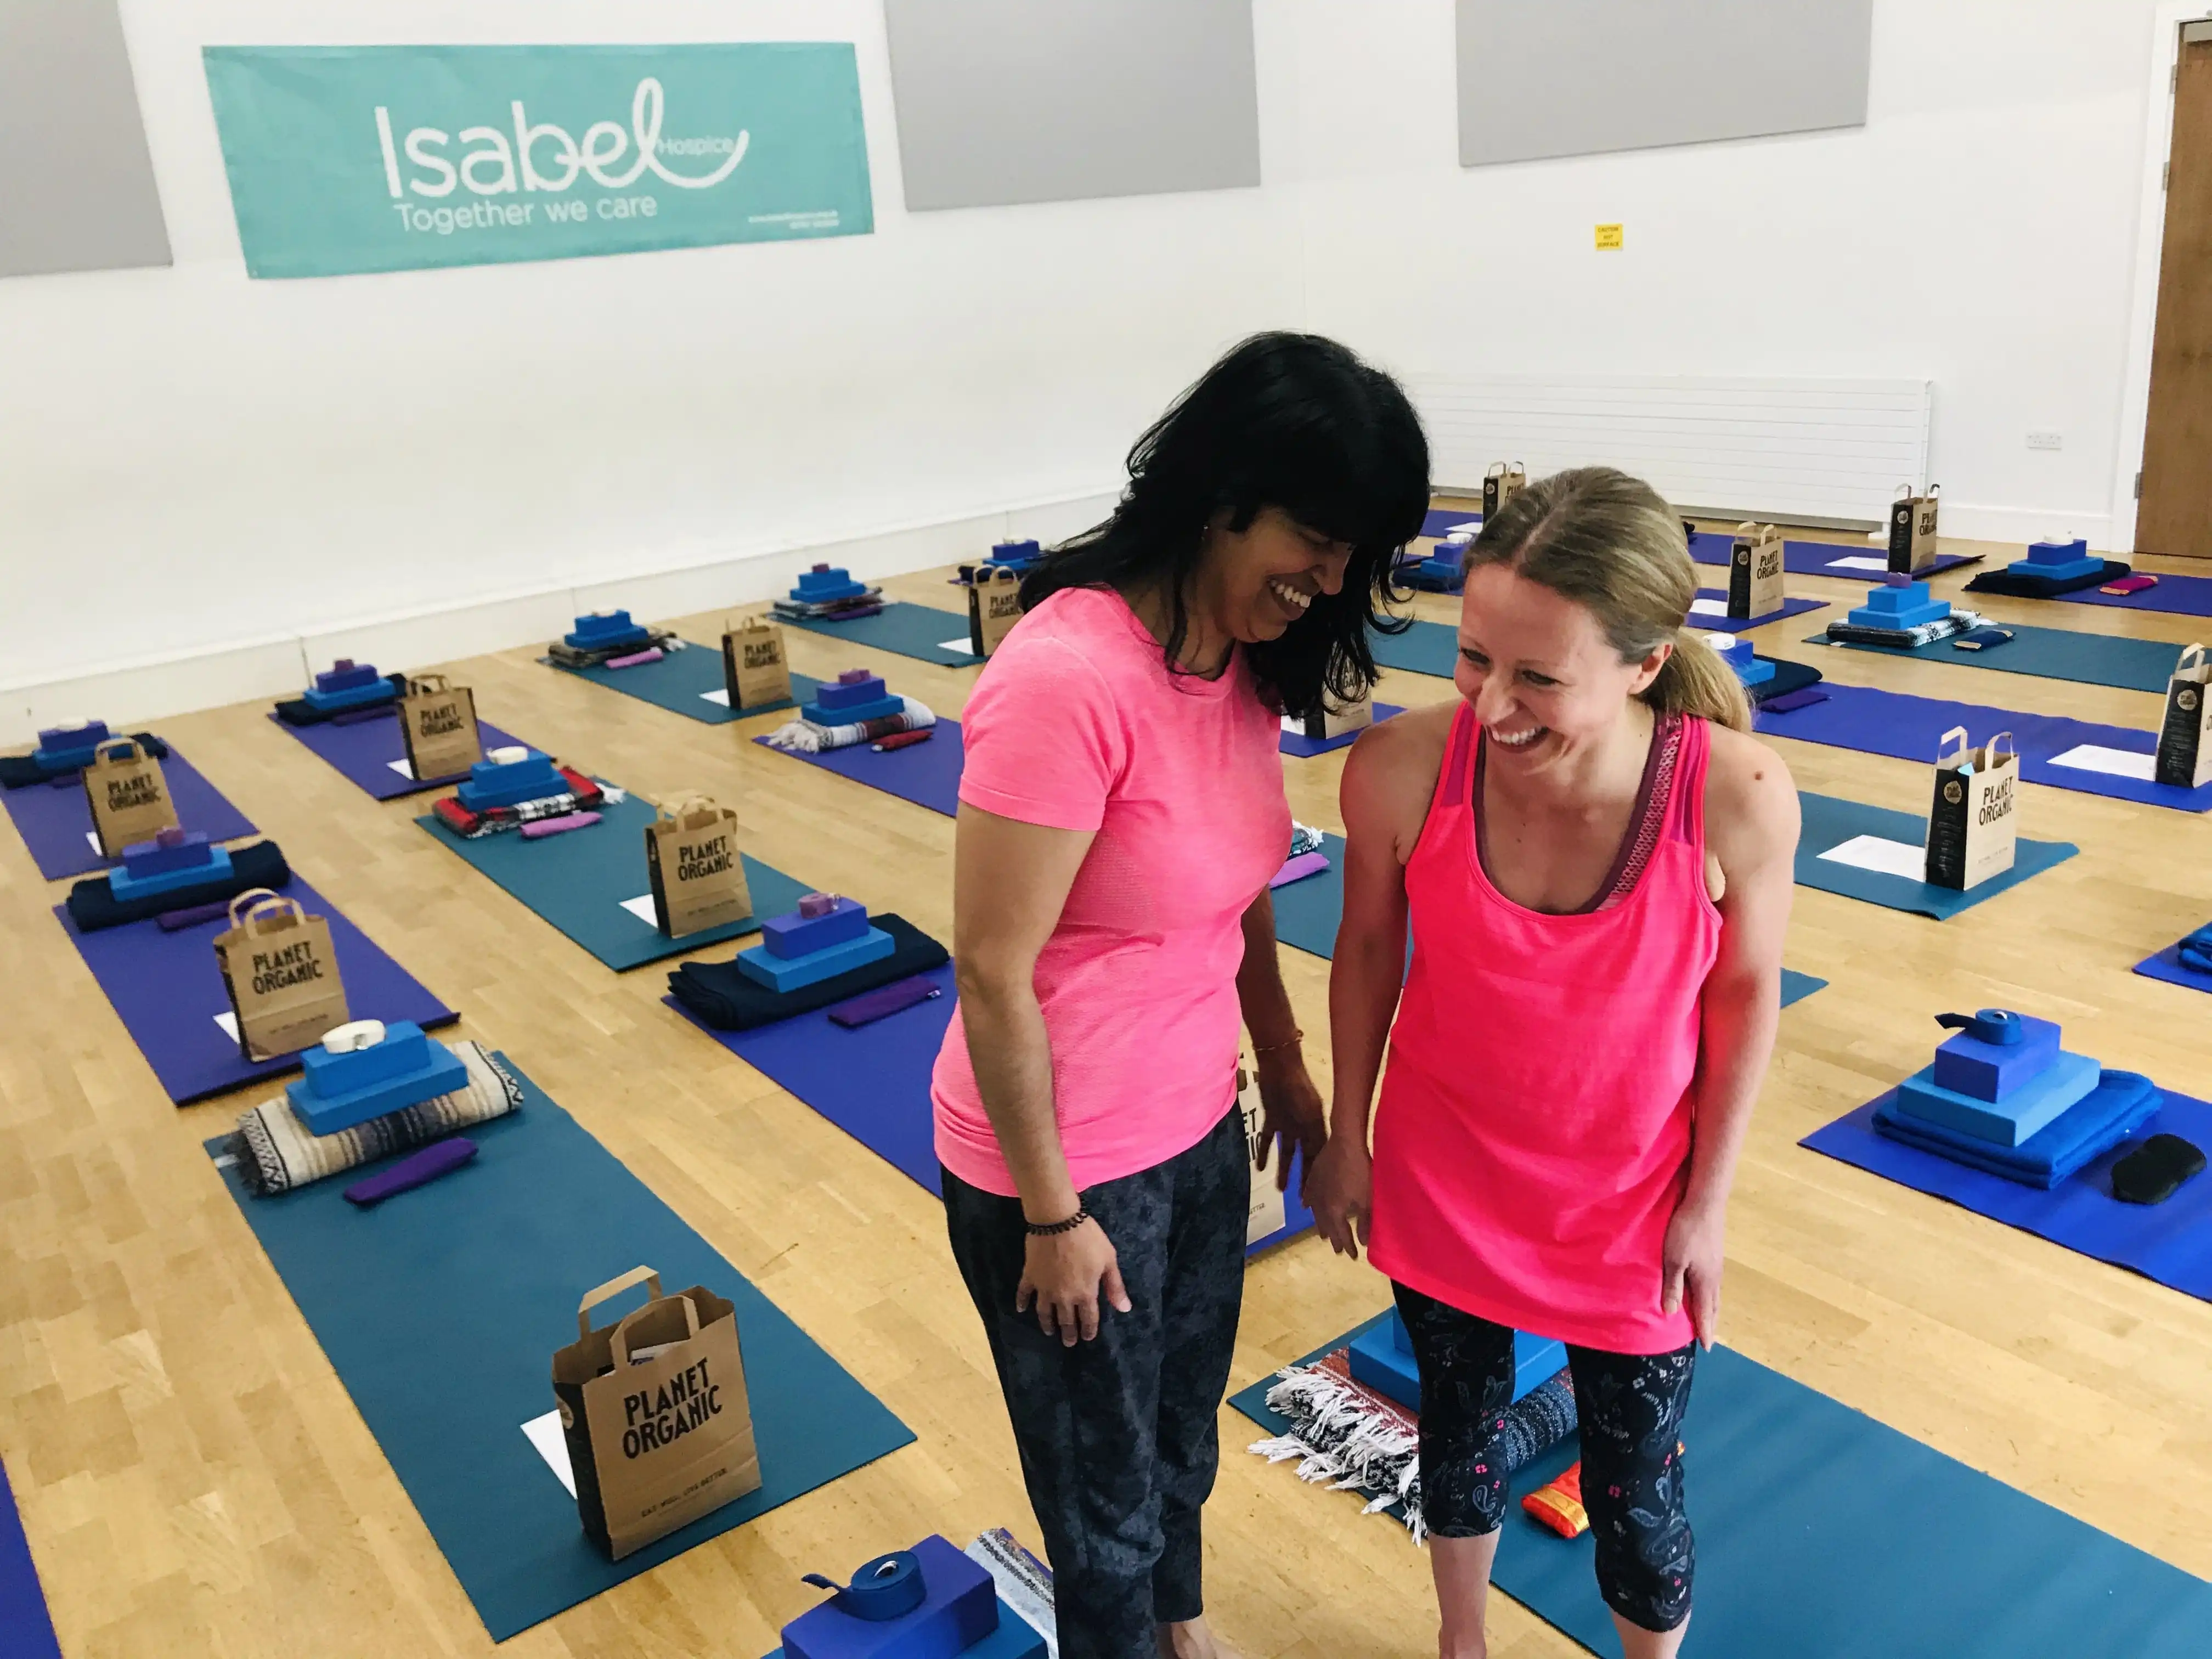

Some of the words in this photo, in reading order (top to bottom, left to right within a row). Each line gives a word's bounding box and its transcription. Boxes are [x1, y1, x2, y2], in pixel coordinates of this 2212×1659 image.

[375, 77, 749, 198] Isabel
[658, 136, 735, 157] Hospice
[393, 200, 535, 235] Together
[544, 199, 588, 223] we
[596, 195, 658, 220] care
[1983, 776, 2013, 805] PLANET
[1979, 794, 2014, 826] ORGANIC
[679, 835, 727, 862] PLANET
[678, 852, 734, 882] ORGANIC
[252, 940, 313, 973] PLANET
[252, 960, 325, 995] ORGANIC
[623, 1356, 709, 1427] PLANET
[623, 1385, 723, 1465] ORGANIC
